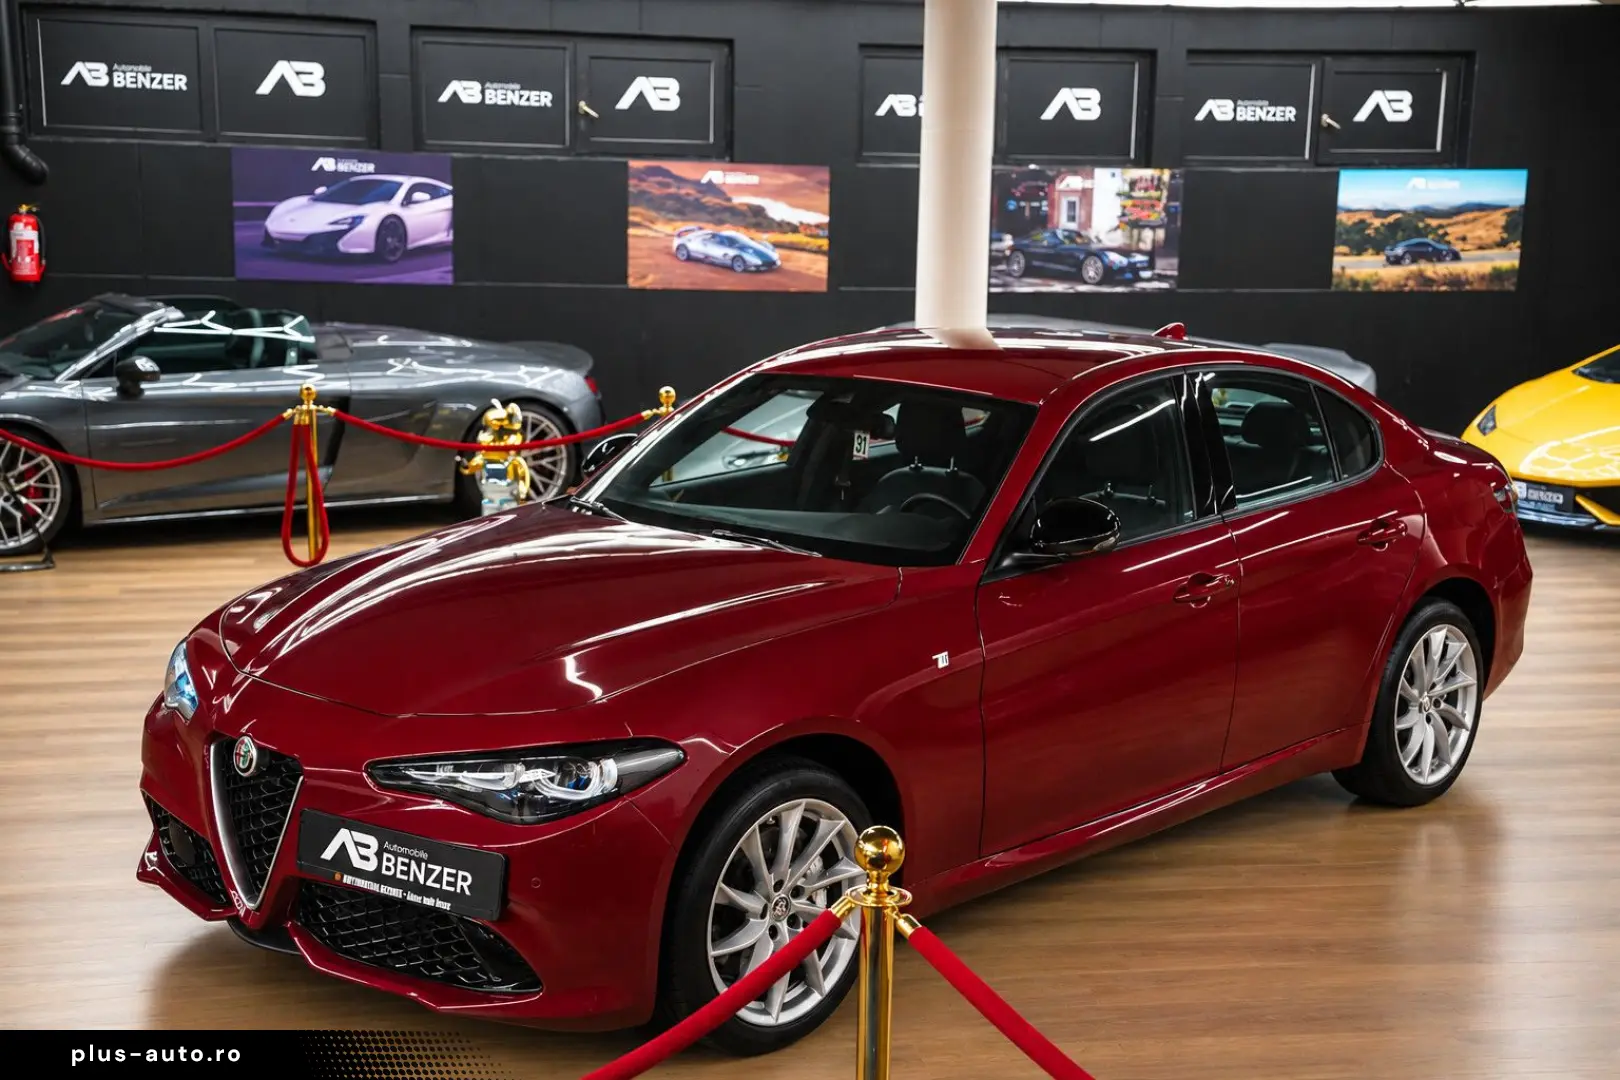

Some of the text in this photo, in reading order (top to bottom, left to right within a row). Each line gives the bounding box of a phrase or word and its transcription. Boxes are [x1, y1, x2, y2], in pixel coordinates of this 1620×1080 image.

[61, 61, 110, 87] AB
[112, 72, 188, 91] BENZER
[255, 60, 326, 97] AB
[438, 80, 482, 104] AB
[484, 89, 553, 107] BENZER
[615, 76, 681, 111] AB
[1040, 87, 1101, 121] AB
[875, 94, 917, 117] AB
[1194, 99, 1235, 121] AB
[1236, 106, 1297, 122] BENZER
[1353, 90, 1413, 122] AB
[856, 434, 867, 455] 31
[320, 827, 379, 872] AB
[383, 841, 429, 861] Automobile
[381, 852, 473, 896] BENZER
